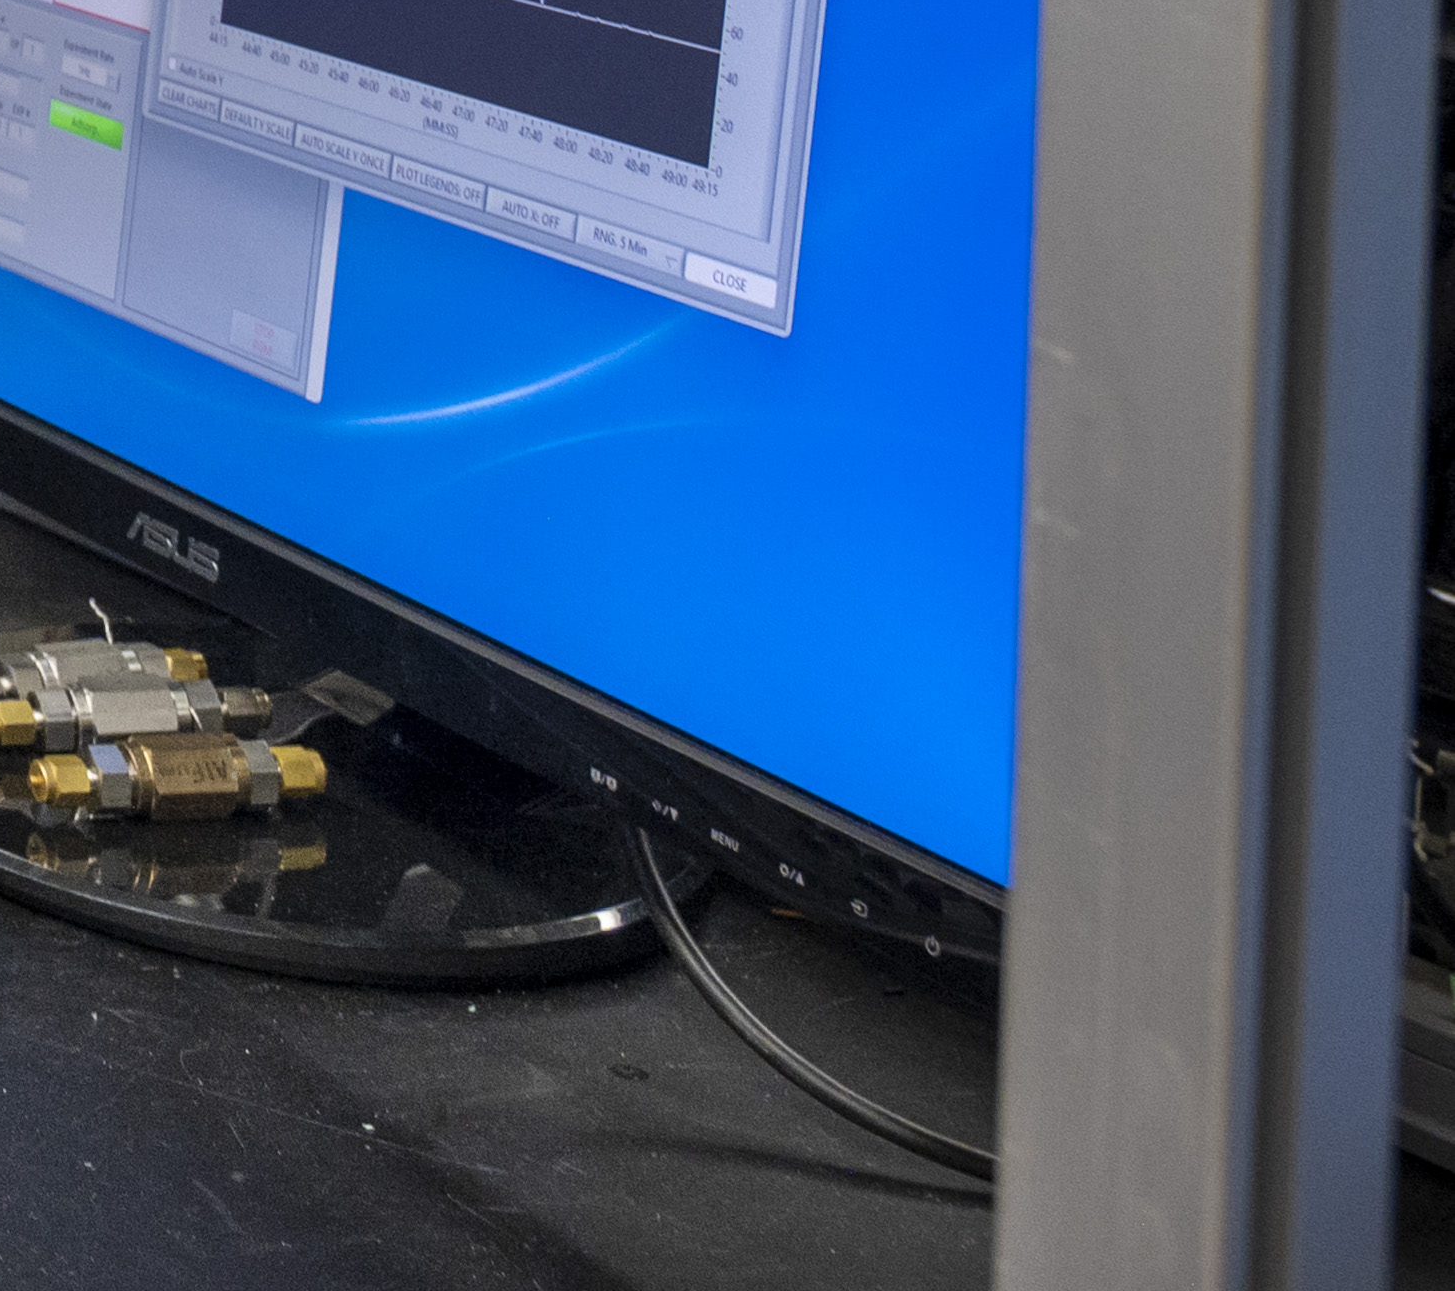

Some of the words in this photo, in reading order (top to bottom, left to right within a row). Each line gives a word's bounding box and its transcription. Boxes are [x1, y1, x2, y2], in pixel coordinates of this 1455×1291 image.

[730, 25, 744, 42] 60
[725, 71, 739, 88] 40
[161, 86, 186, 103] CLEAR
[186, 94, 217, 113] CHARTS
[224, 105, 258, 127] DEFAULT
[266, 120, 292, 141] SCALE
[720, 117, 734, 135] 20
[300, 132, 325, 151] AUTO
[325, 140, 351, 161] SCALE
[360, 150, 385, 172] ONCE
[452, 103, 476, 124] 47:00
[484, 113, 509, 134] 47:20
[517, 123, 544, 145] 47:40
[552, 133, 578, 155] 48:00
[587, 144, 614, 166] 48:20
[623, 155, 651, 177] 48:40
[661, 166, 688, 188] 49:00
[691, 175, 719, 198] 49:15
[395, 164, 419, 182] PLOT
[420, 171, 463, 198] LEGENDS:
[463, 186, 482, 203] OFF
[502, 200, 529, 221] AUTO
[541, 211, 561, 230] OFF
[627, 237, 648, 257] Min
[711, 267, 748, 293] CLOSE
[126, 510, 220, 584] ASUS
[710, 827, 740, 853] MENU
